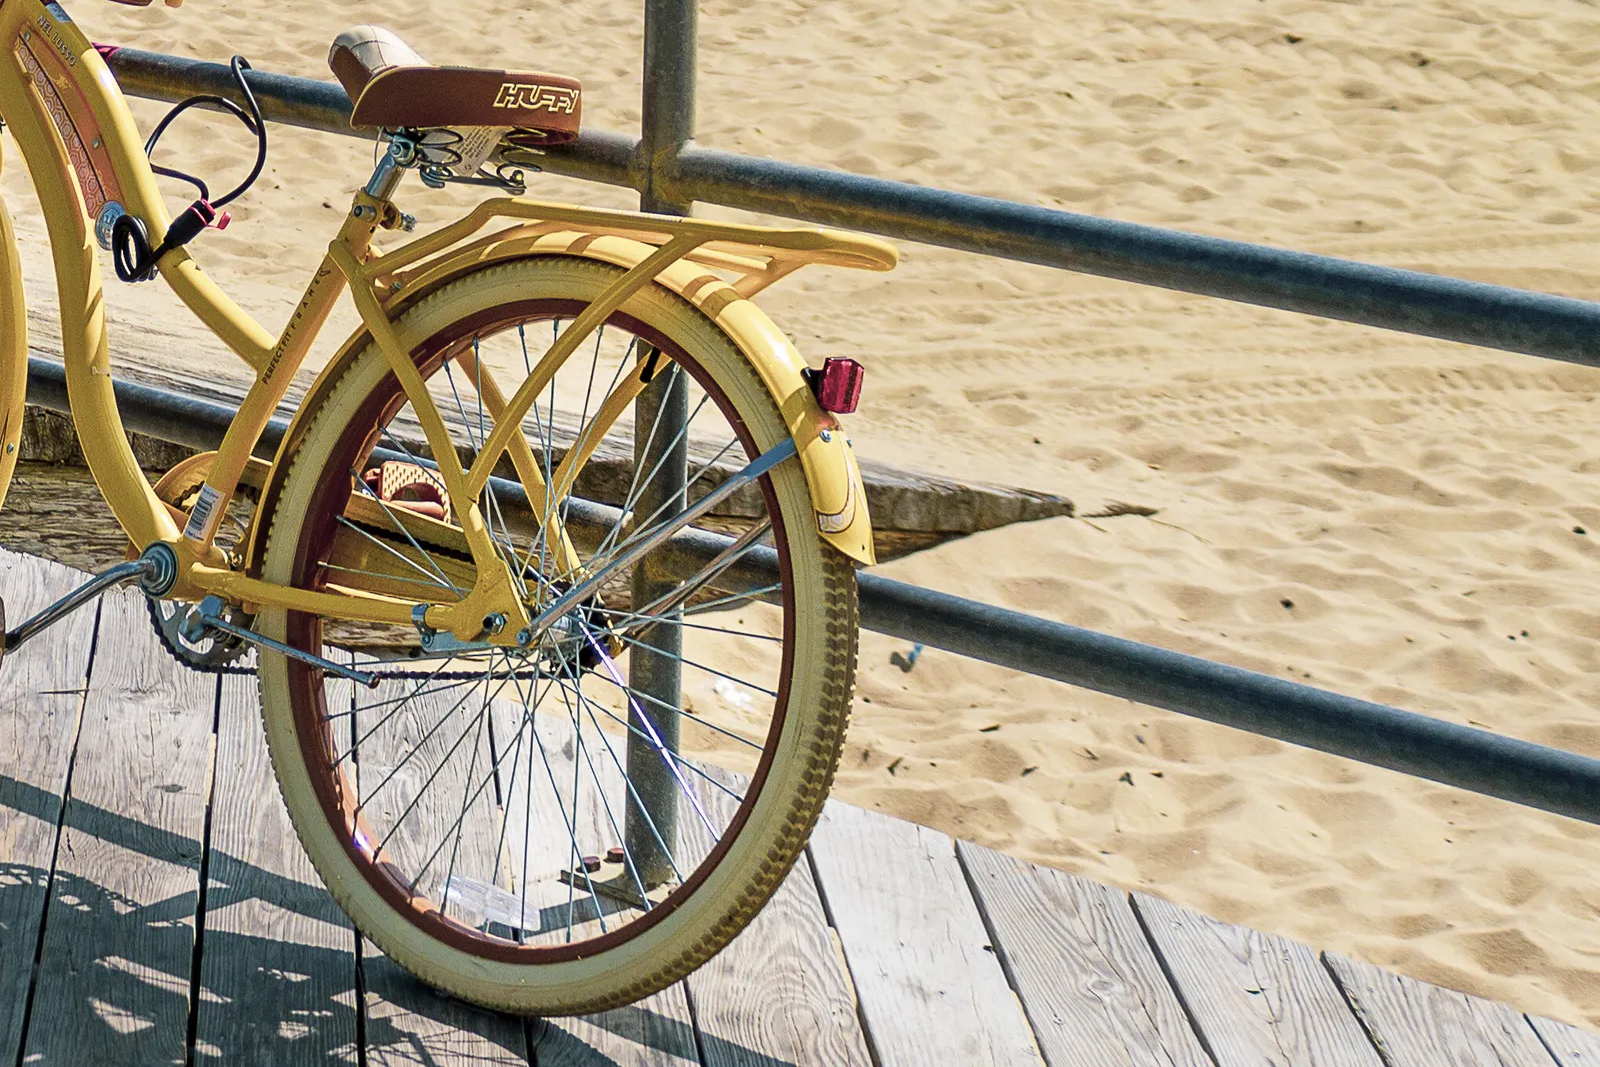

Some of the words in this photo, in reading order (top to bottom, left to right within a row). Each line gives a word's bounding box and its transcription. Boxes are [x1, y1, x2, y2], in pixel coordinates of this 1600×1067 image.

[37, 14, 52, 37] NEL
[52, 32, 77, 67] LUSSO
[493, 83, 579, 114] HUFFY
[262, 347, 286, 385] PERFECT
